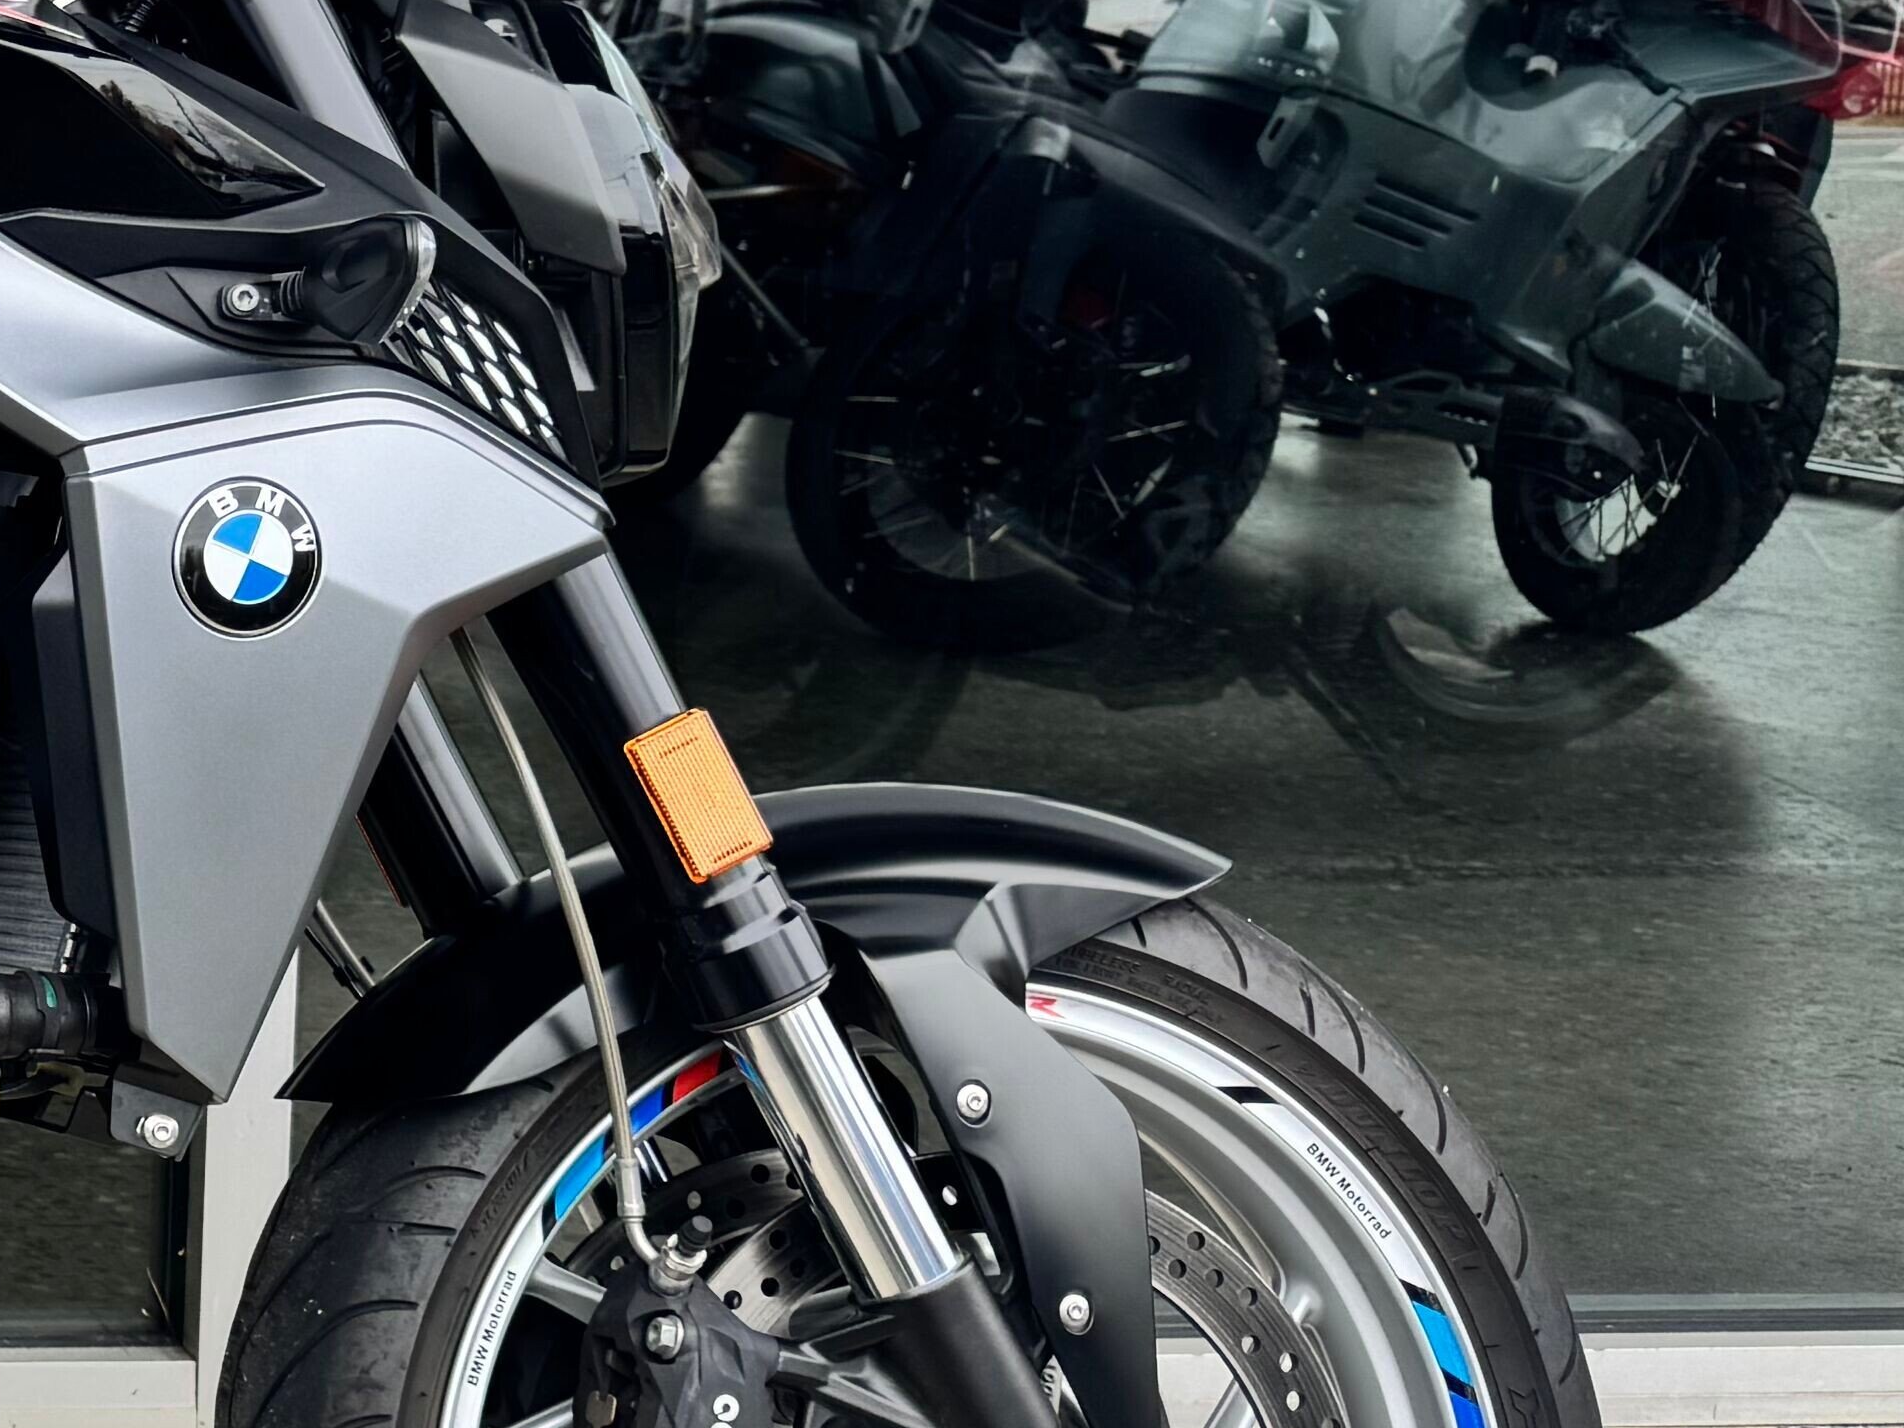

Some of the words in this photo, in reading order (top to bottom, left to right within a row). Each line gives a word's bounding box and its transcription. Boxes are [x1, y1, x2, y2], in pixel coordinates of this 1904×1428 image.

[208, 486, 316, 553] BMW
[1307, 1143, 1341, 1177] BMW
[1337, 1177, 1392, 1240] Motorrad
[467, 1345, 488, 1386] BMW
[482, 1270, 517, 1343] Motorrad
